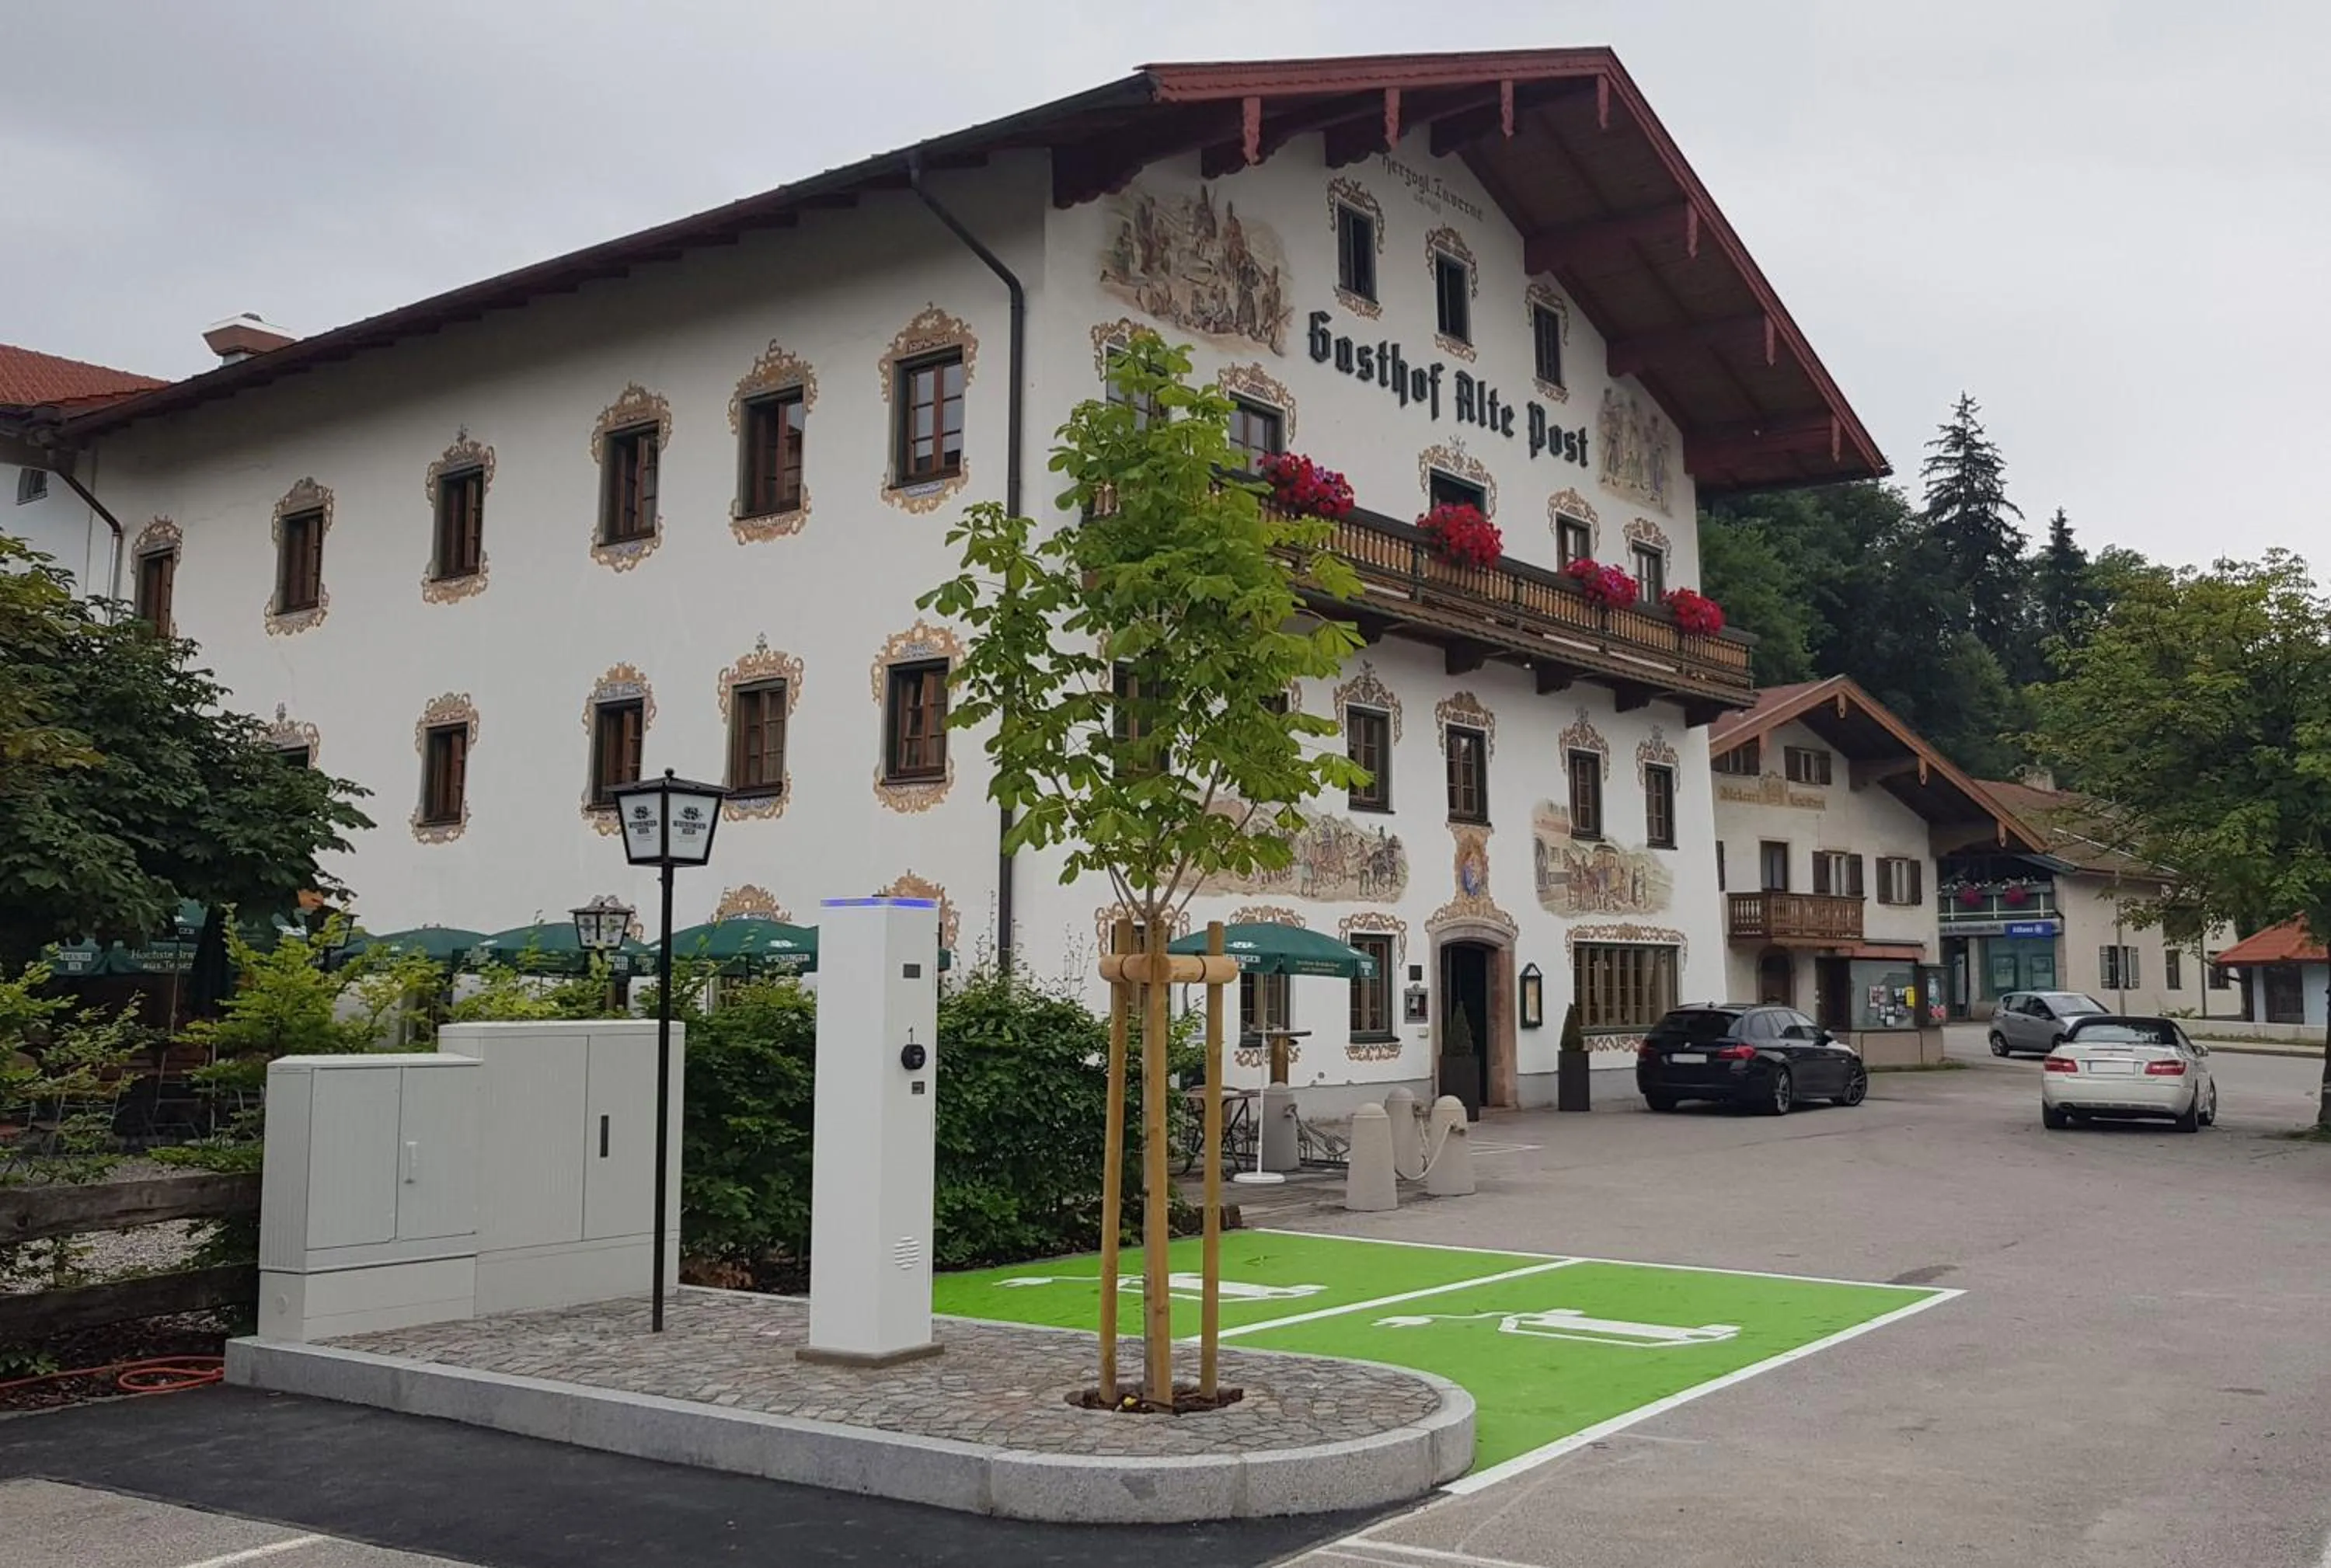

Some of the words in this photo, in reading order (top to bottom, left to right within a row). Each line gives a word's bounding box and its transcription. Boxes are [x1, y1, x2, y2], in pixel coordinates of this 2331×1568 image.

[1308, 311, 1444, 420] Gasthof
[1455, 369, 1515, 438] Alte
[1527, 401, 1589, 468] Post
